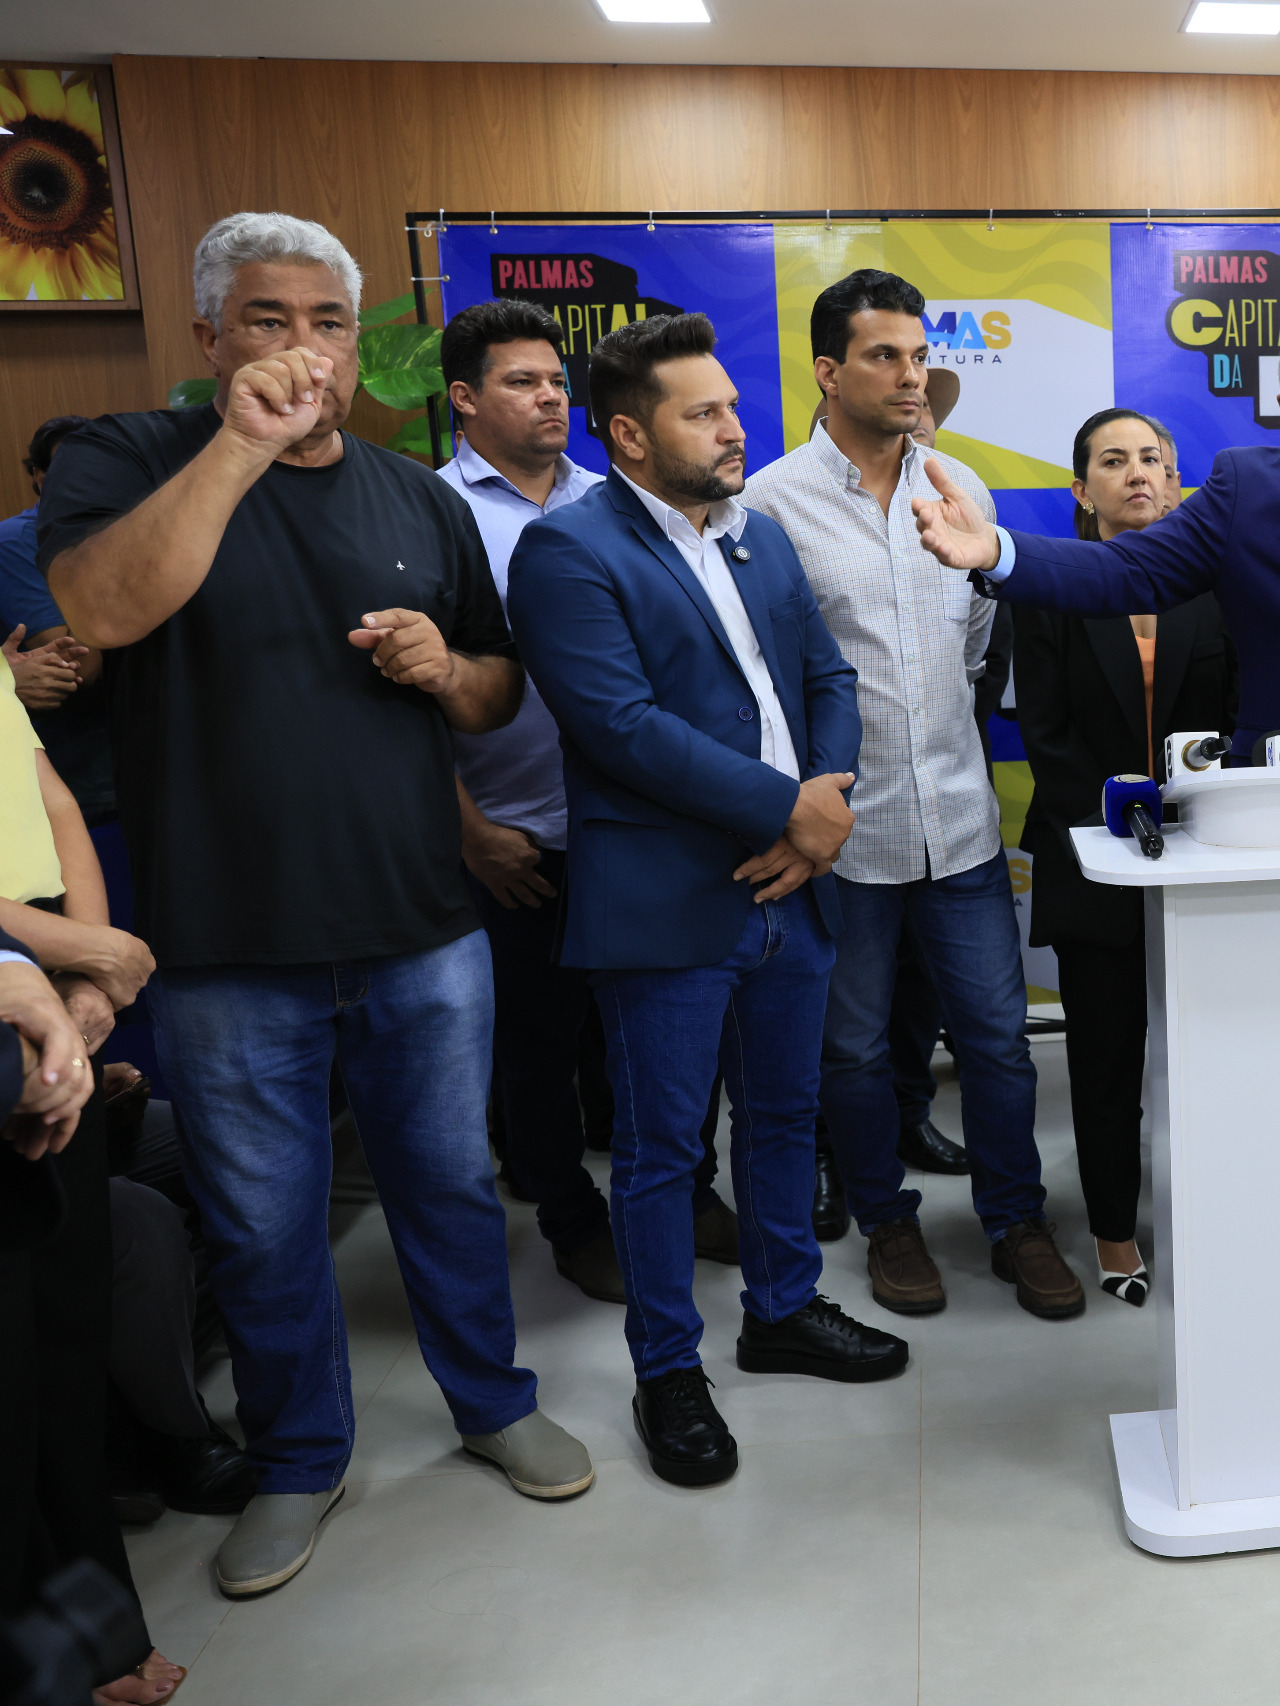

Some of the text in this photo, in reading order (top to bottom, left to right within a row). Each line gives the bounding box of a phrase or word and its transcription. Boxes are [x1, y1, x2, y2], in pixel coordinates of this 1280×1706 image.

[499, 260, 594, 288] PALMAS
[1180, 256, 1268, 283] PALMAS
[920, 311, 1012, 349] MAS
[927, 354, 1002, 364] ITURA
[1213, 354, 1242, 388] DA
